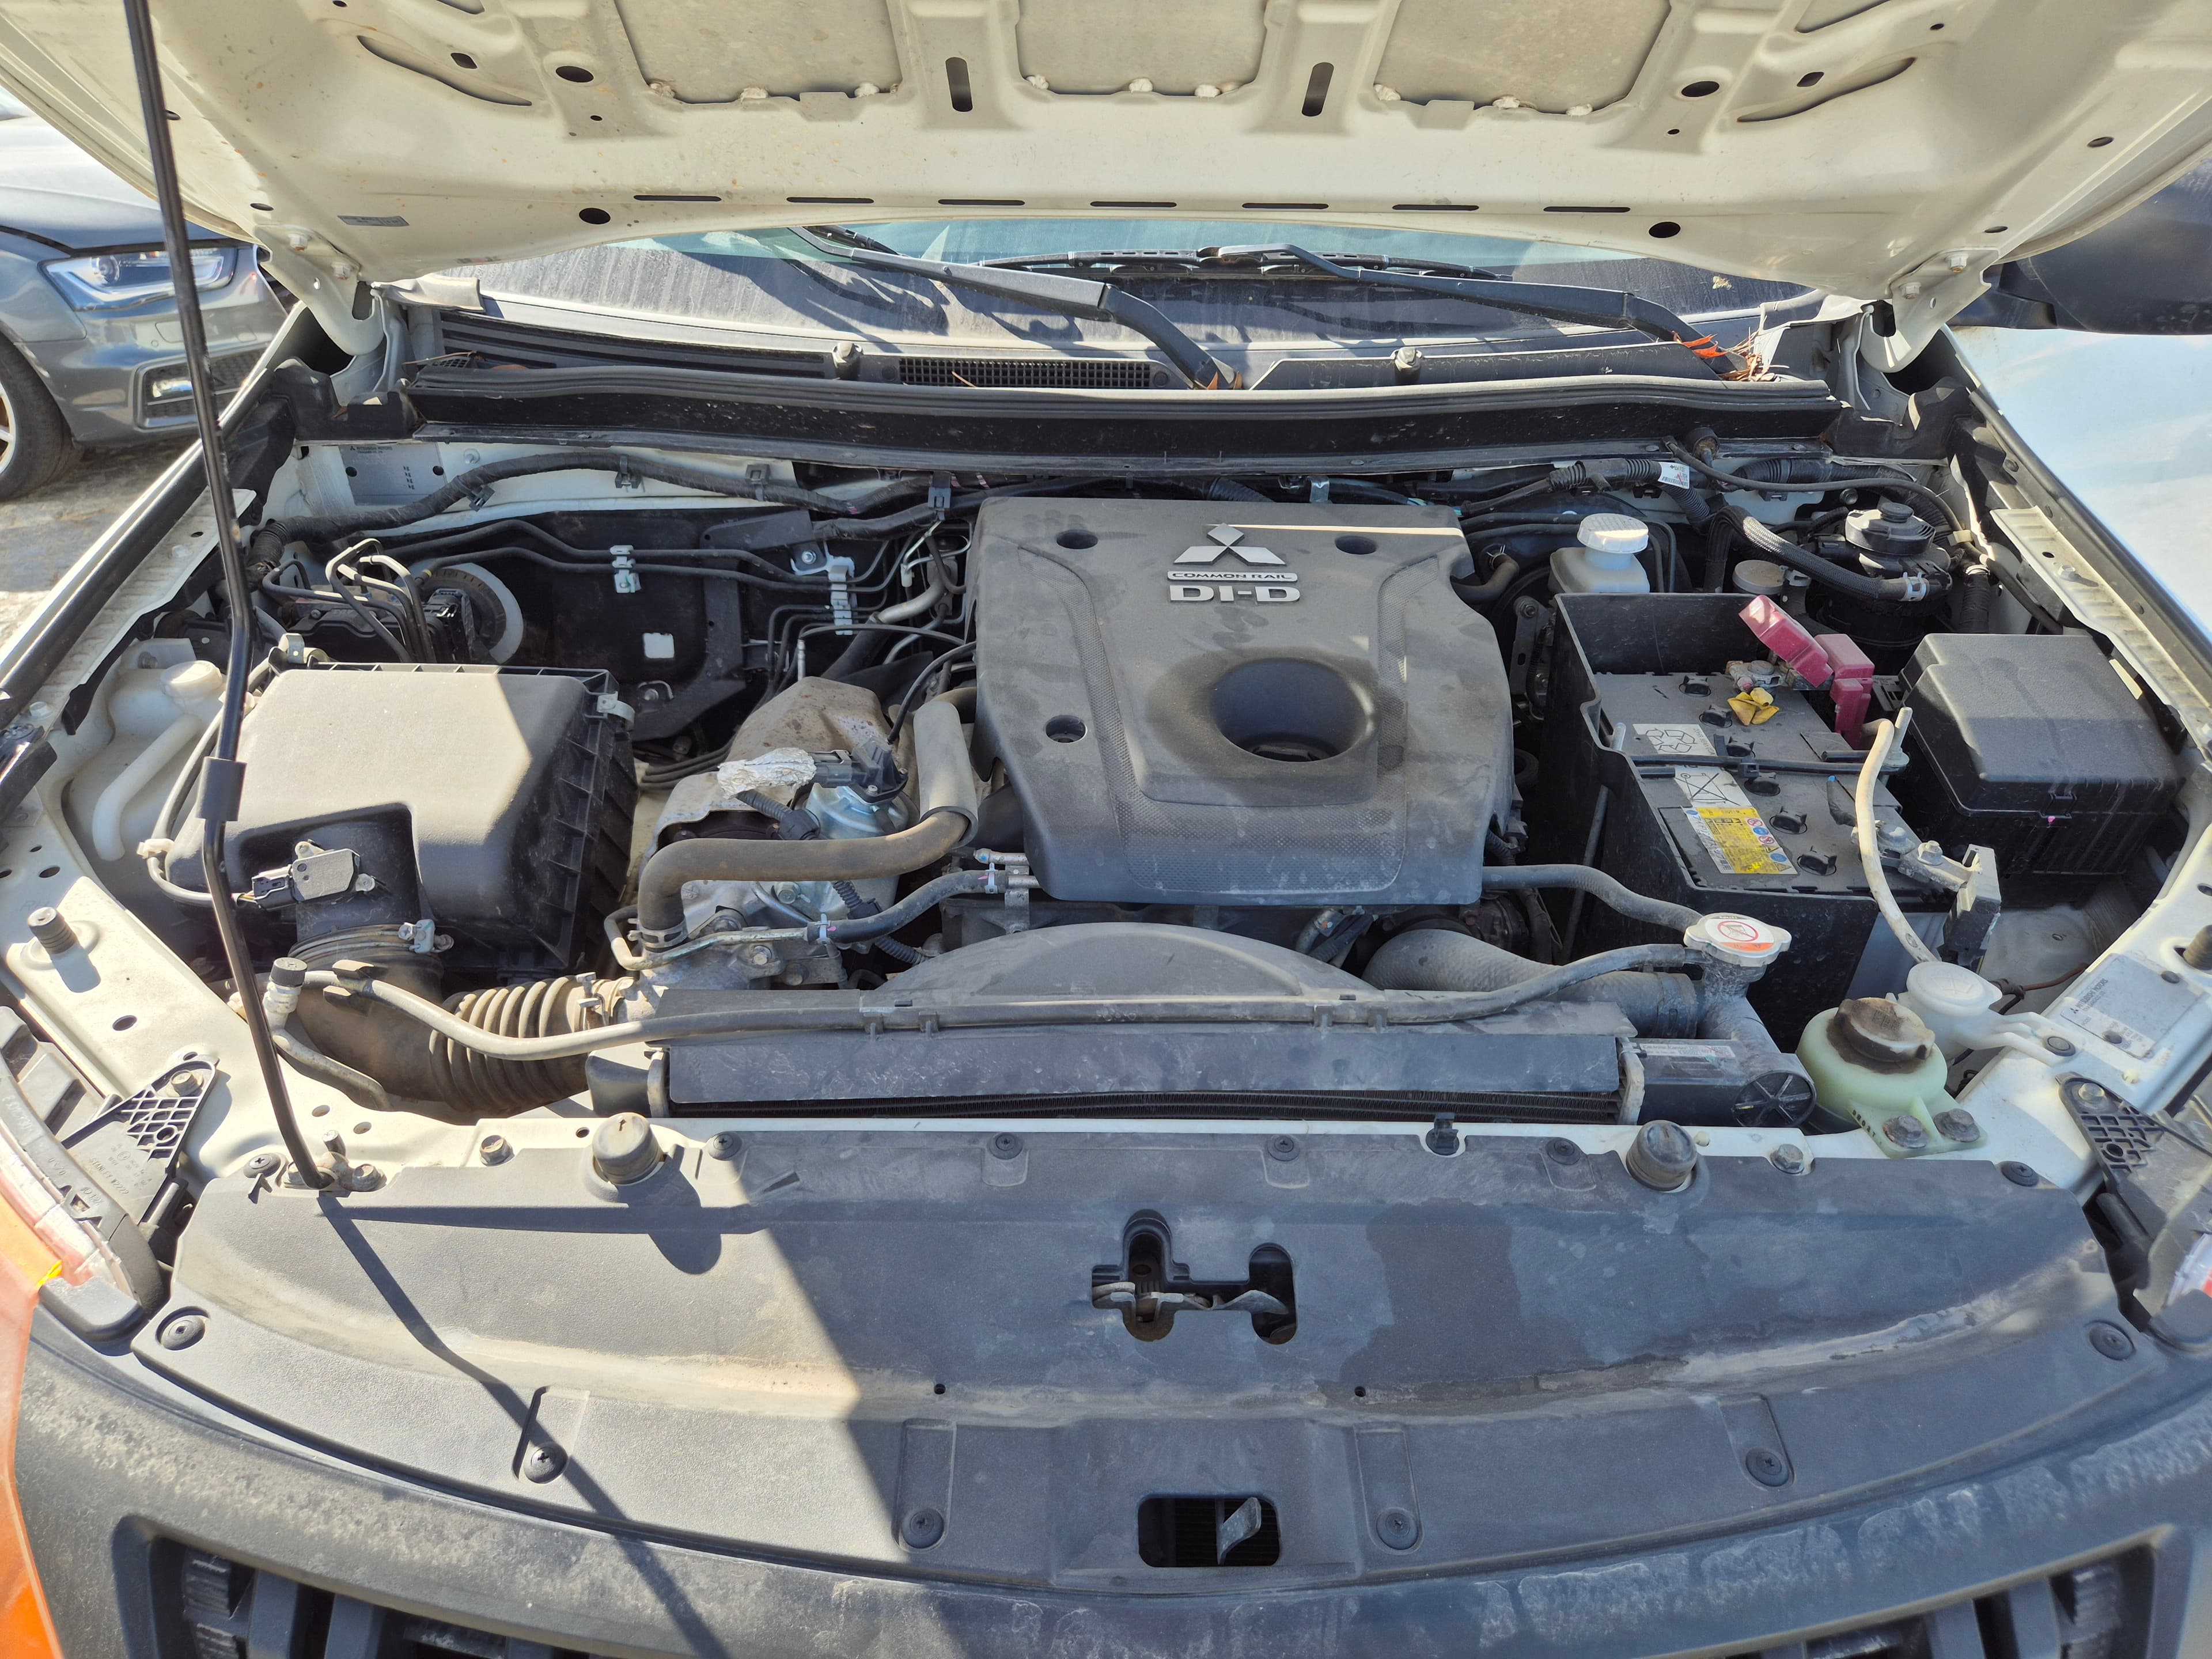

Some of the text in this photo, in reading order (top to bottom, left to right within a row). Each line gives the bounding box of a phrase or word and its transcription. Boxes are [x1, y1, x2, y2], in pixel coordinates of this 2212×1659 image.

[1169, 585, 1301, 601] DI-D
[2075, 990, 2096, 1009] MITSUBISHI
[2091, 978, 2108, 991] MOTORS
